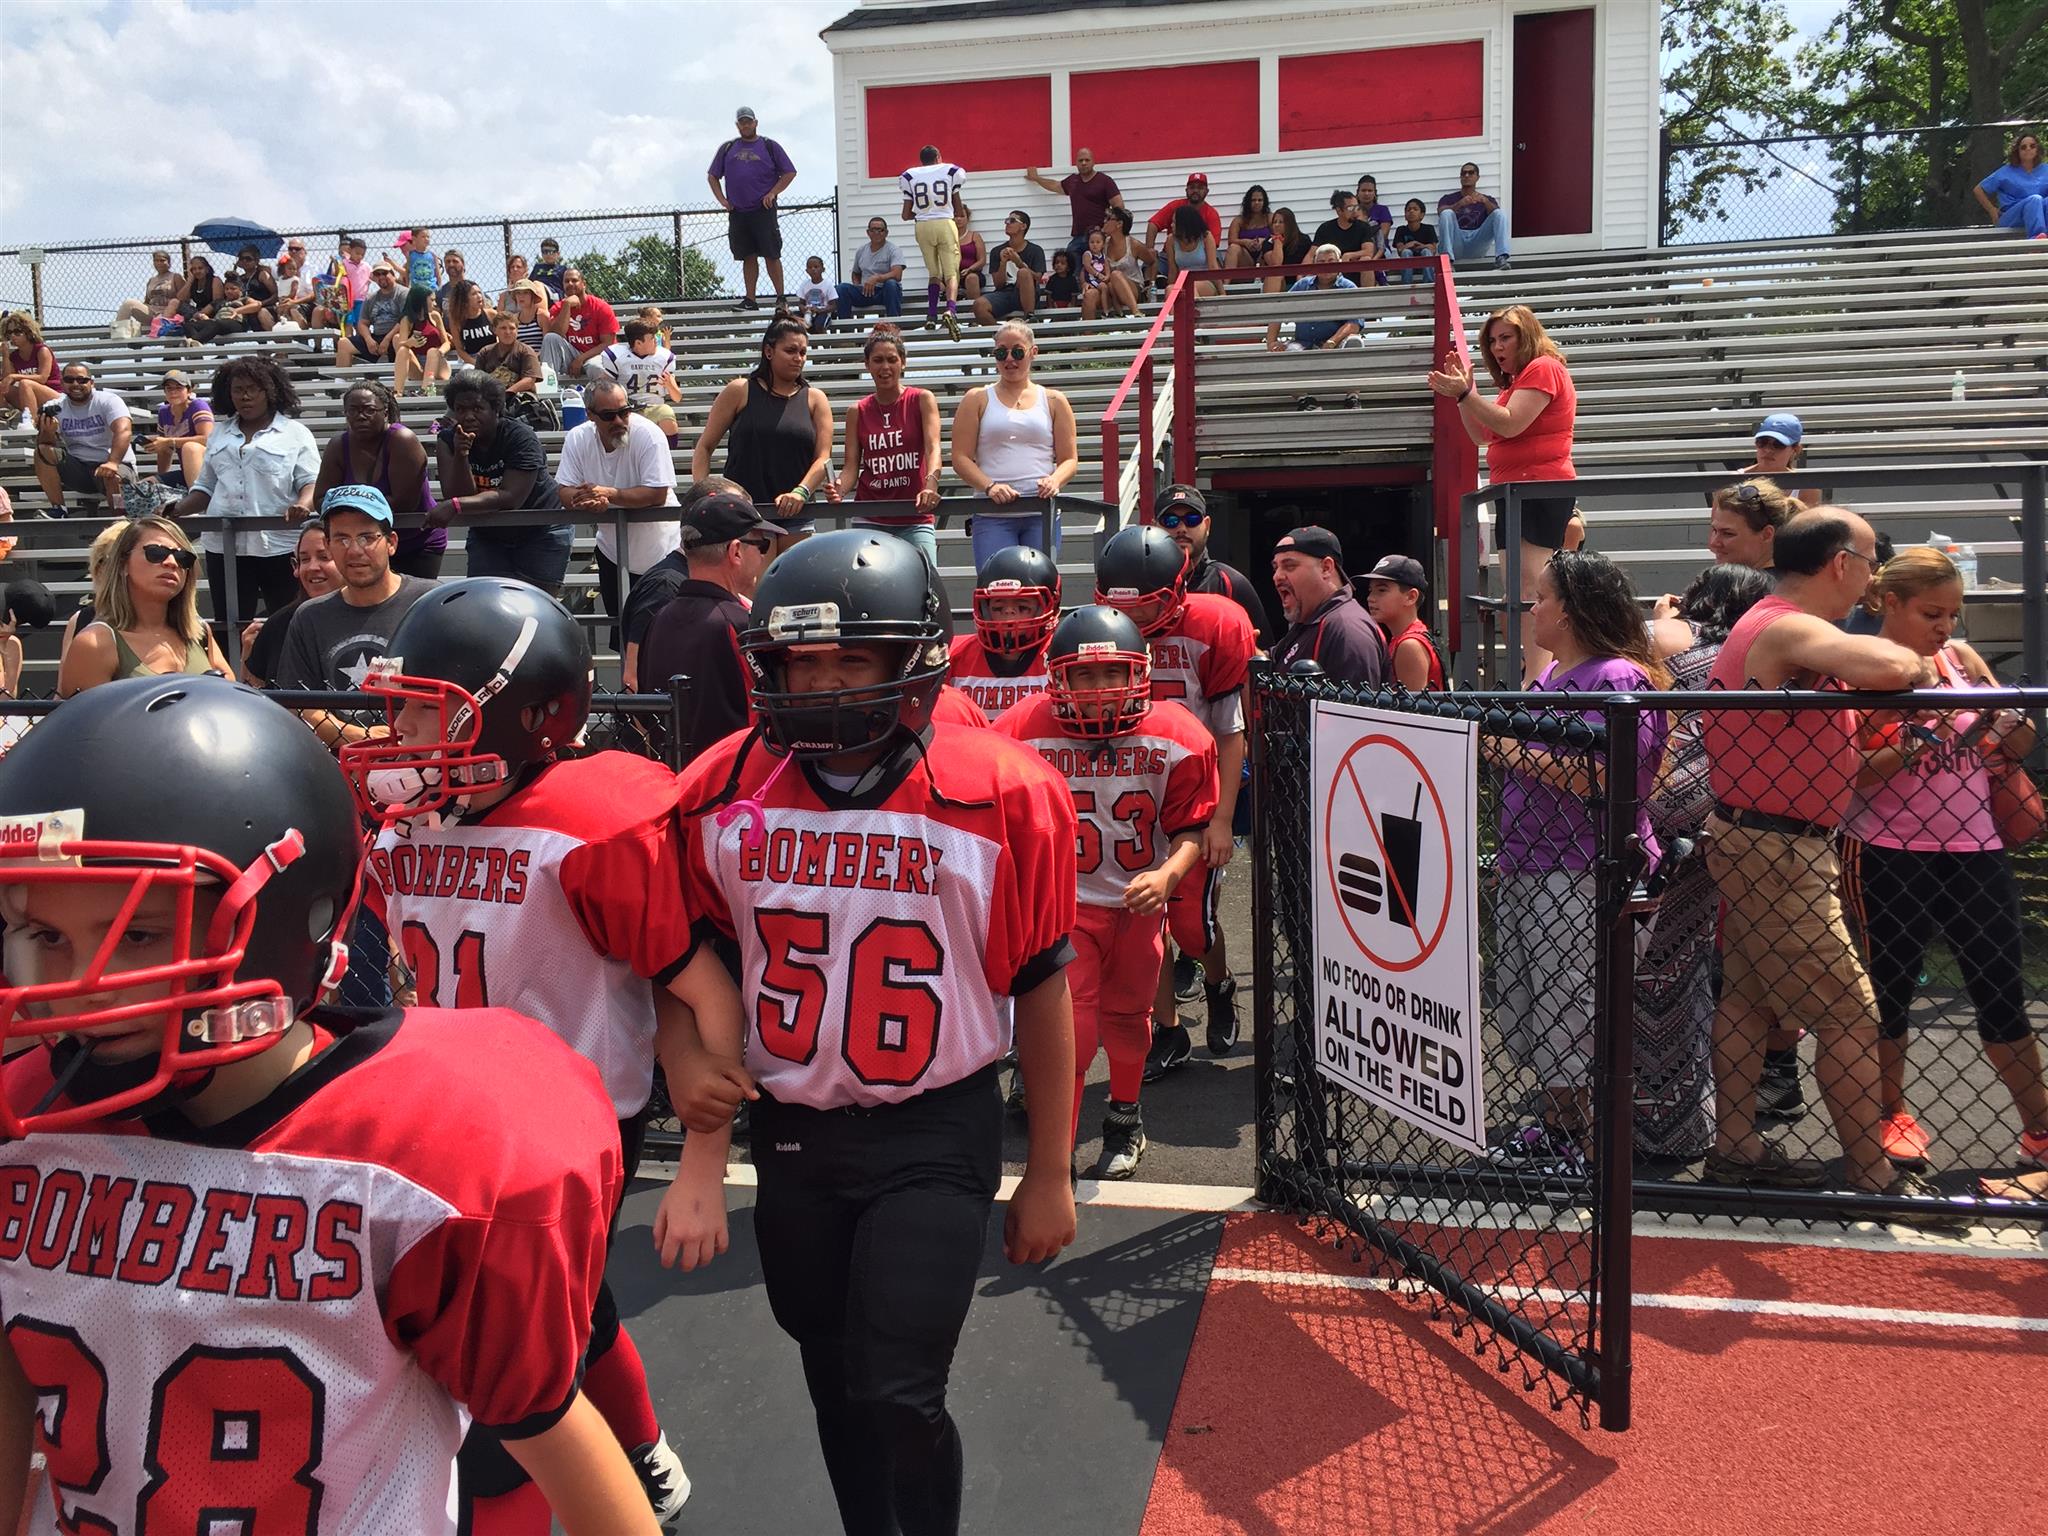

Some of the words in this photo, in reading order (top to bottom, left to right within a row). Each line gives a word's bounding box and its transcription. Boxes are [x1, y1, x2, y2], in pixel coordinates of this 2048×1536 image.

[914, 180, 949, 209] 89
[462, 325, 493, 340] PINK
[568, 335, 593, 344] RWB
[626, 374, 659, 394] 42
[62, 415, 105, 431] GARFIELD
[883, 413, 892, 428] I
[869, 430, 903, 450] HATE
[792, 608, 818, 617] schutt
[903, 643, 925, 678] NDER
[960, 685, 1055, 710] OMBE
[447, 707, 470, 743] UNDER
[1070, 789, 1157, 875] 53
[370, 844, 531, 905] BOMBERS
[754, 907, 944, 1086] 56
[1323, 956, 1341, 986] NO
[1345, 965, 1381, 1004] FOOD
[1385, 983, 1406, 1016] OR
[1411, 992, 1462, 1039] DRINK
[1325, 995, 1464, 1088] ALLOWED
[1325, 1037, 1349, 1071] ON
[1355, 1051, 1393, 1094] THE
[1400, 1073, 1466, 1126] FIELD
[0, 1164, 363, 1302] BOMBERS
[4, 1313, 327, 1536] 28
